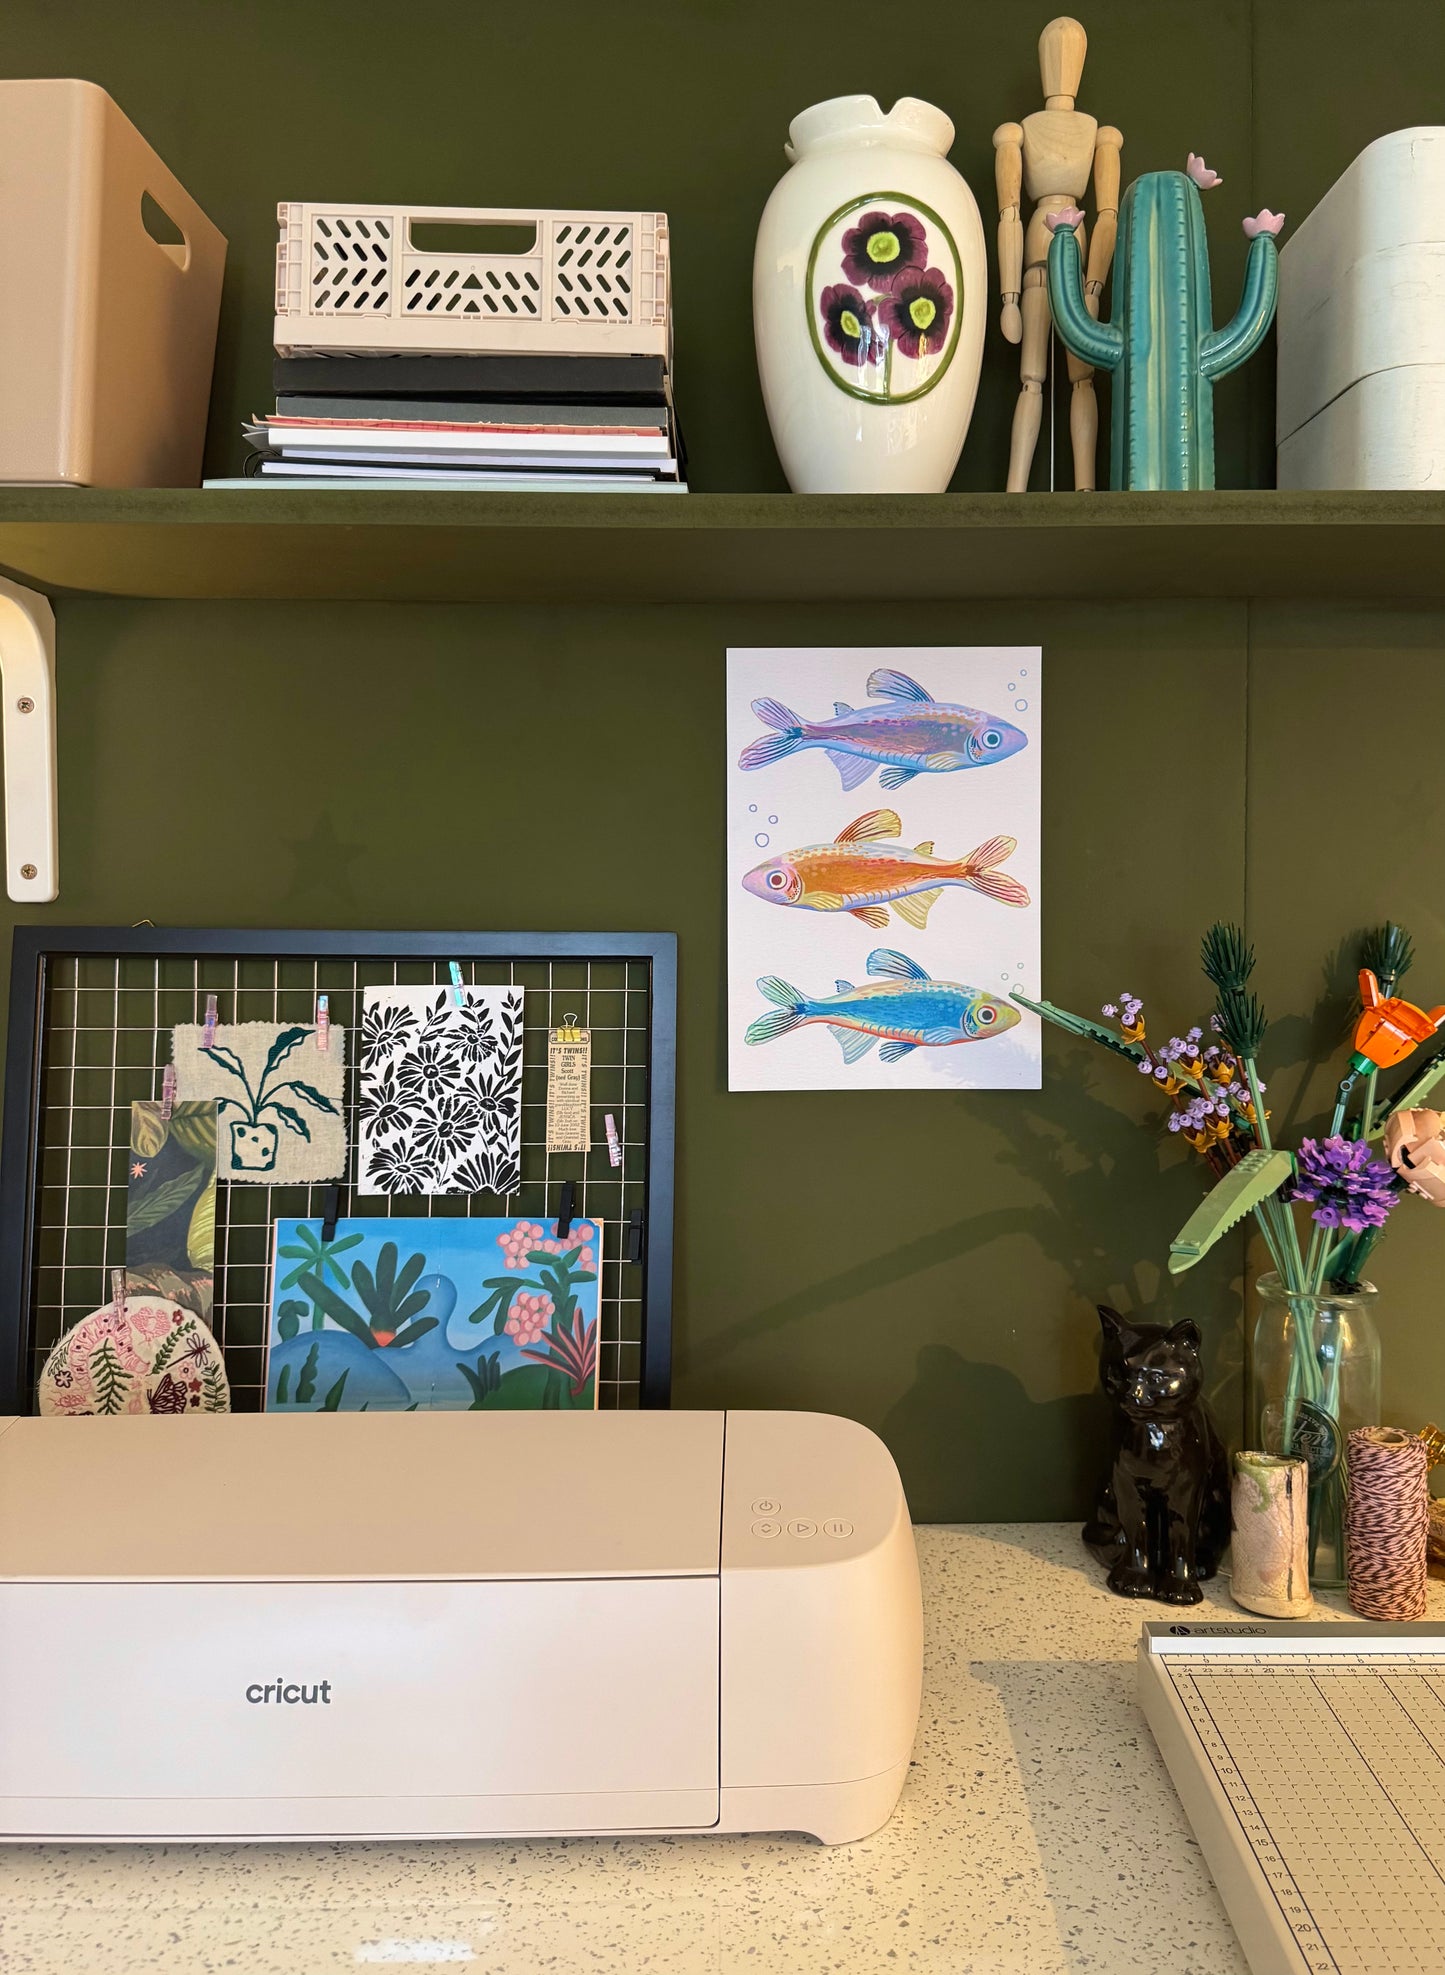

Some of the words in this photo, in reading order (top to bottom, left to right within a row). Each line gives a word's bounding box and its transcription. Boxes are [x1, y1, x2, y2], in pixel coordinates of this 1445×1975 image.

[1194, 1625, 1266, 1635] artstudio
[246, 1677, 332, 1704] cricut
[1295, 1924, 1311, 1932] 20
